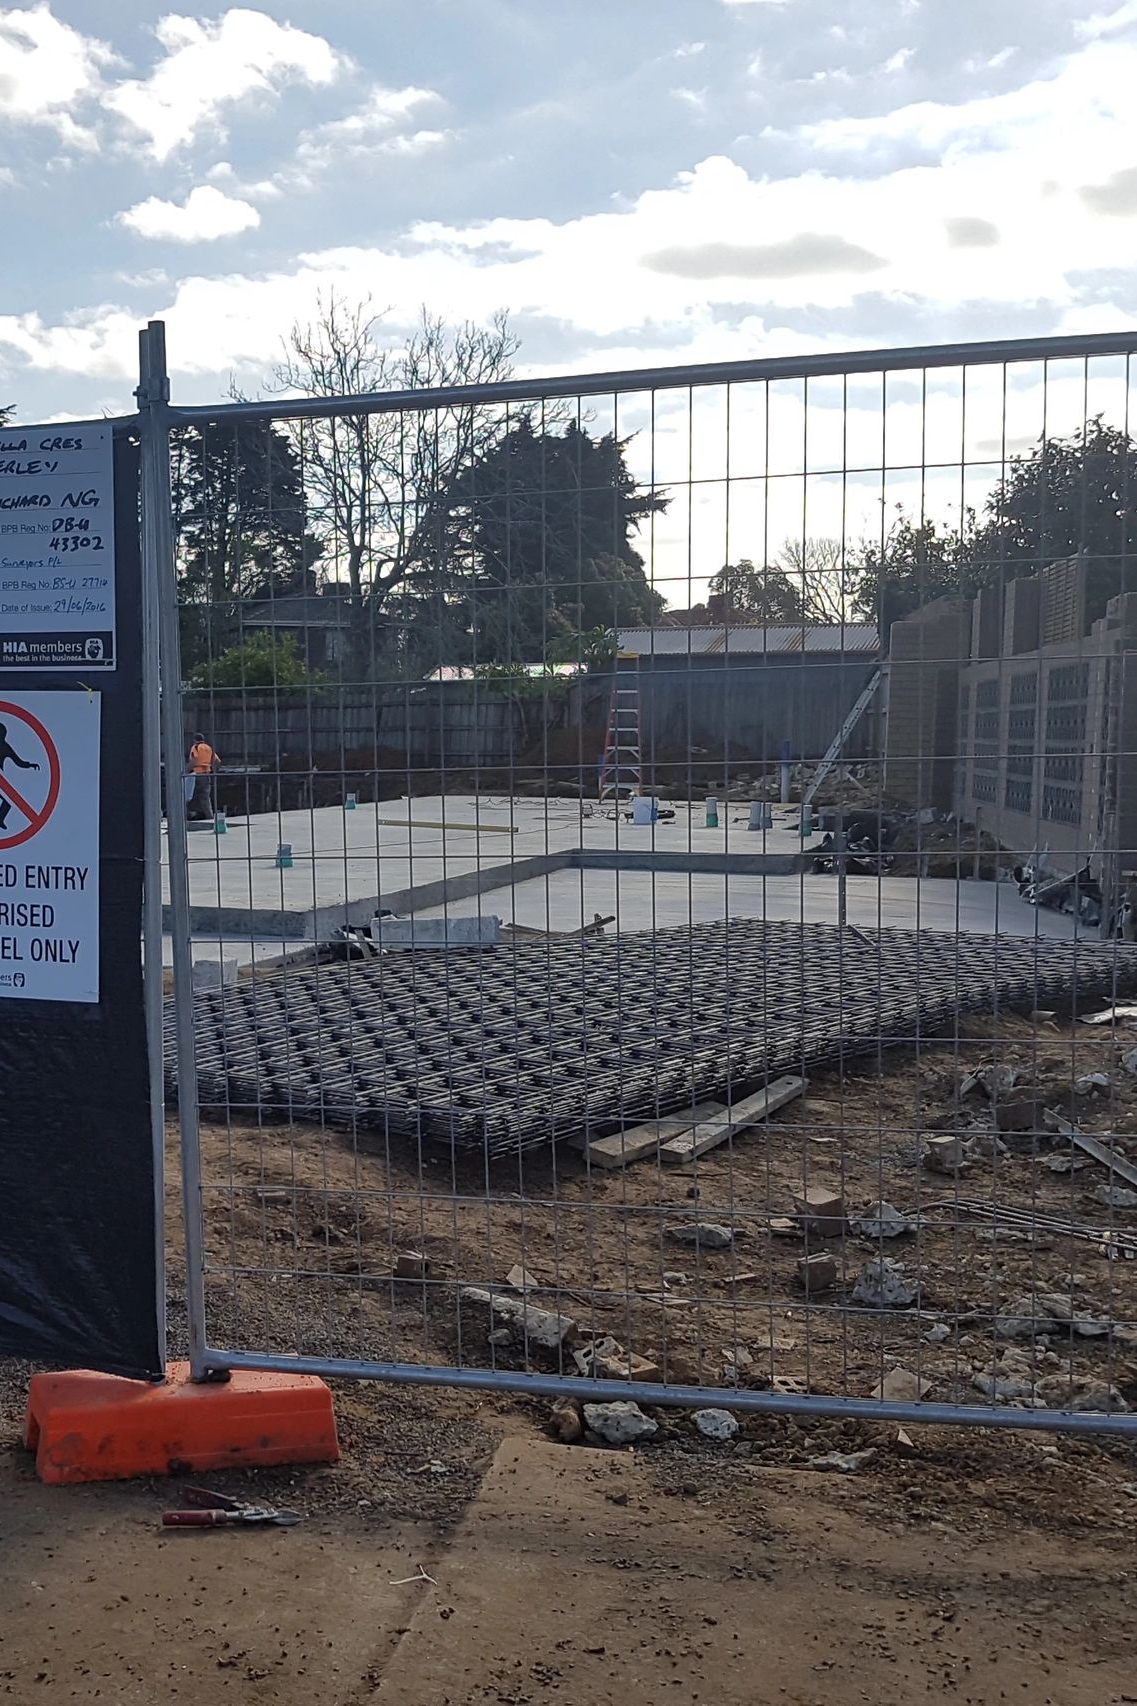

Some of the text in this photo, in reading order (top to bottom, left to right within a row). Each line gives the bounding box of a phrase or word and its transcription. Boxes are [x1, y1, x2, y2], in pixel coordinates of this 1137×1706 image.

[39, 437, 83, 451] CRES
[60, 489, 100, 507] NG
[1, 524, 18, 533] BPB
[49, 536, 104, 552] 43302
[1, 557, 43, 571] Surveyors
[2, 580, 36, 591] BPB Reg
[2, 603, 19, 612] Date
[20, 603, 28, 612] of
[53, 595, 106, 616] 29/06/2016
[3, 640, 83, 653] HIA members
[2, 653, 83, 662] the best in the business
[25, 865, 89, 890] ENTRY
[30, 938, 80, 964] ONLY
